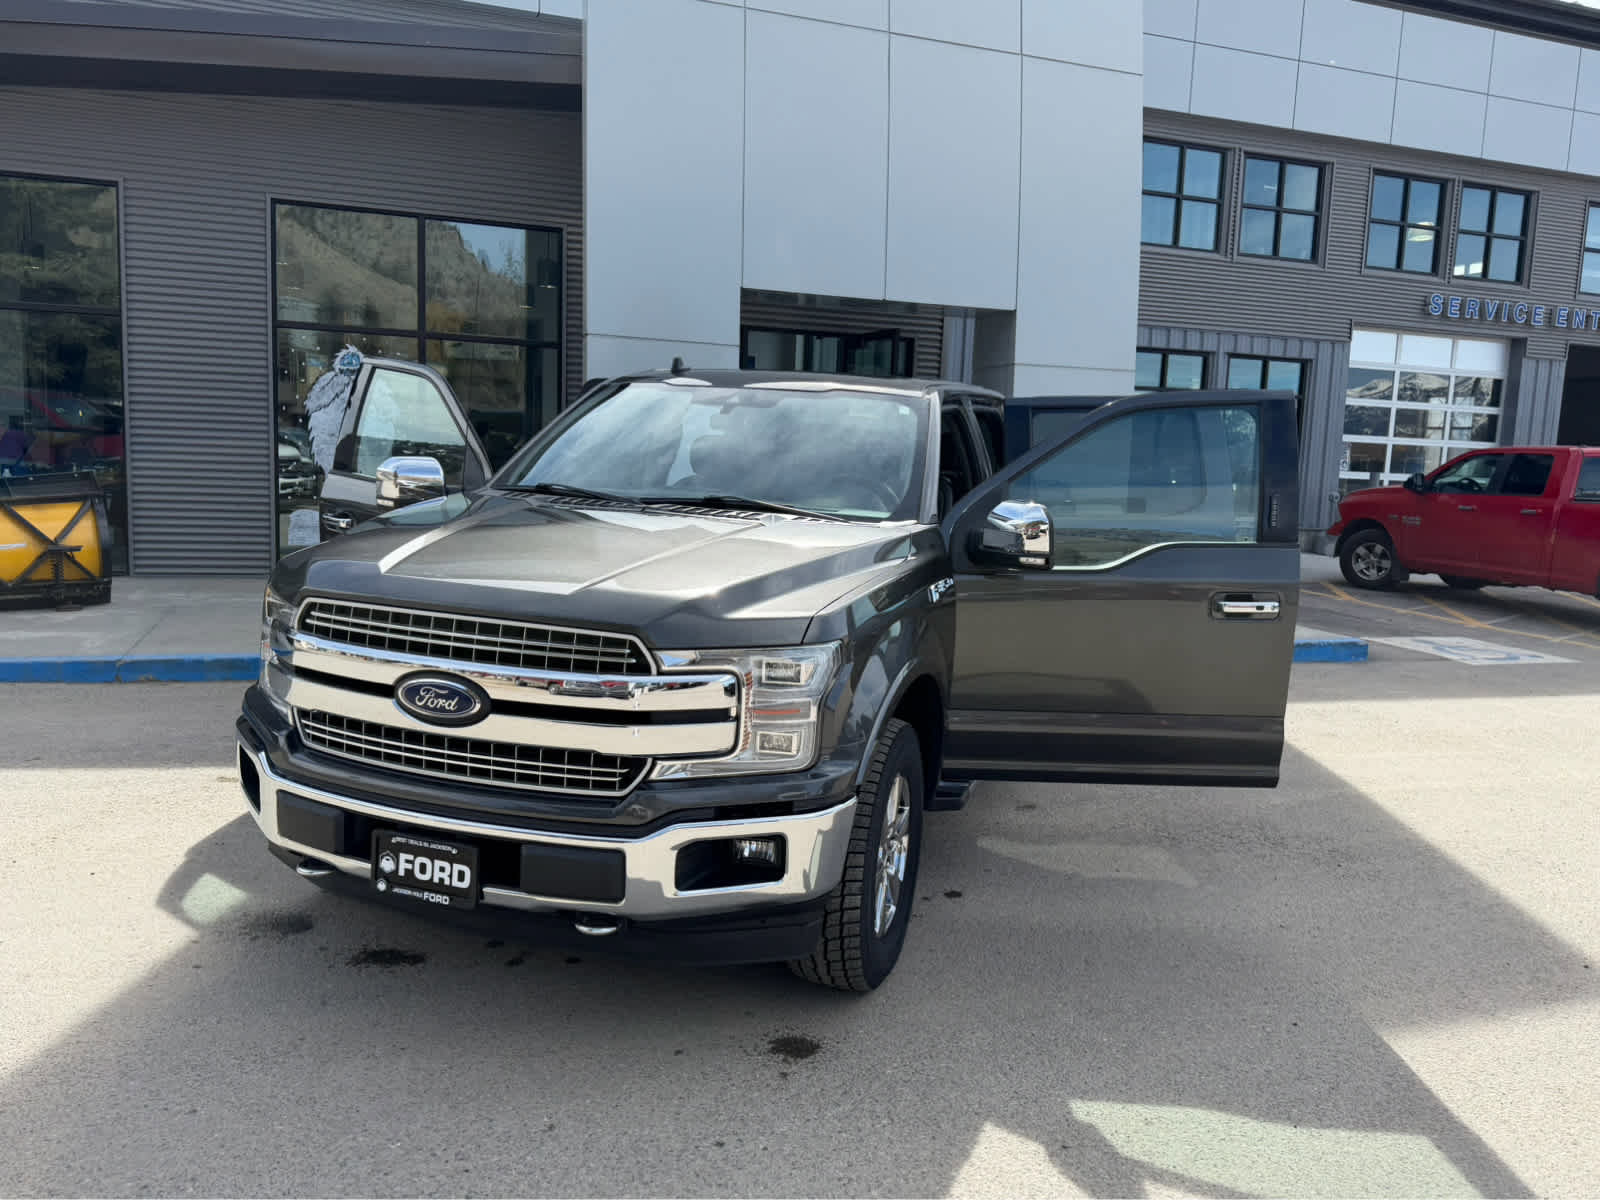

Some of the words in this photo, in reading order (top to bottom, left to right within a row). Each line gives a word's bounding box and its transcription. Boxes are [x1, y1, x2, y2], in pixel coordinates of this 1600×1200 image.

[1429, 293, 1545, 326] SERVICE
[415, 686, 460, 711] Ford
[398, 852, 471, 889] FORD
[423, 891, 450, 905] FORD
